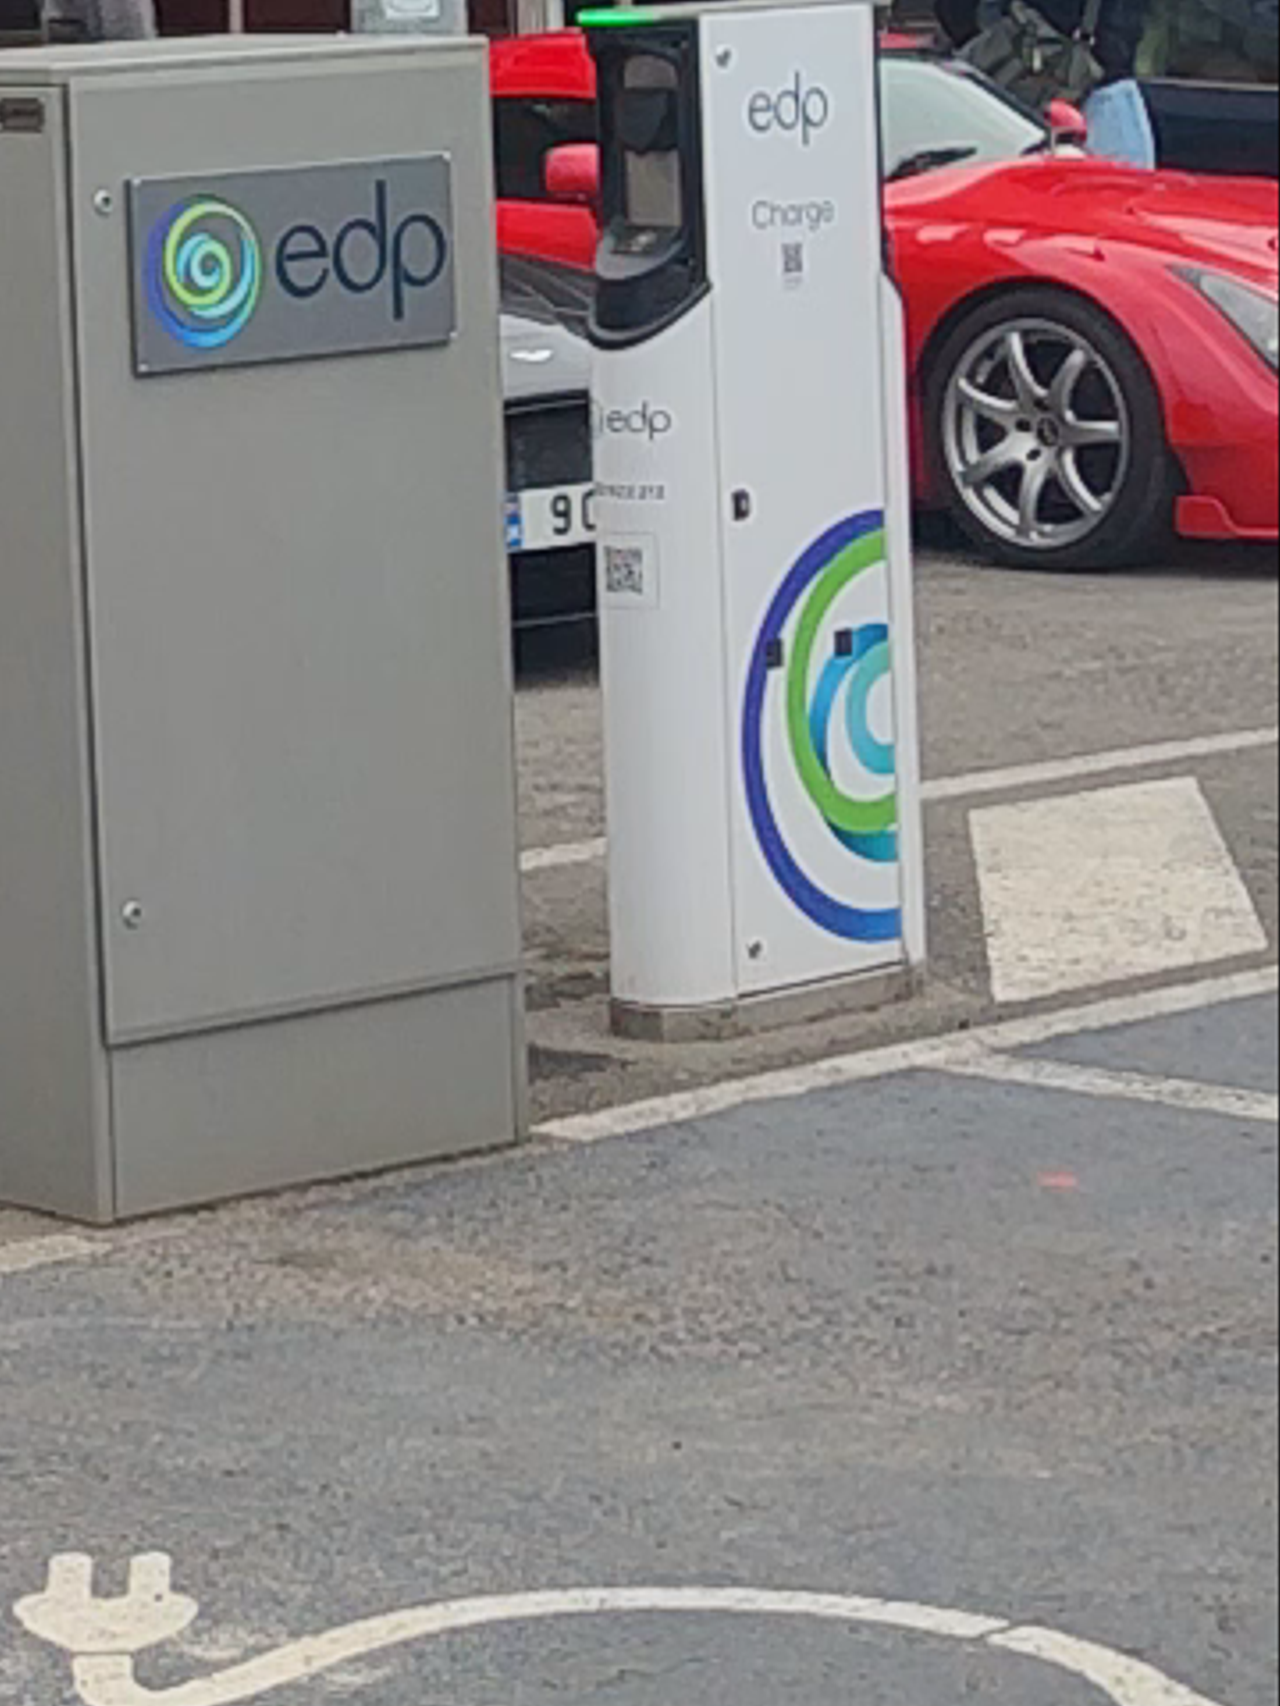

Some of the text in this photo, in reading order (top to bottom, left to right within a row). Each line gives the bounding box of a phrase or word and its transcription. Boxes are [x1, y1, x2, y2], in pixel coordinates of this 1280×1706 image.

[748, 70, 828, 147] edp
[751, 200, 835, 232] Charge
[275, 179, 447, 321] edp
[606, 400, 672, 441] edp
